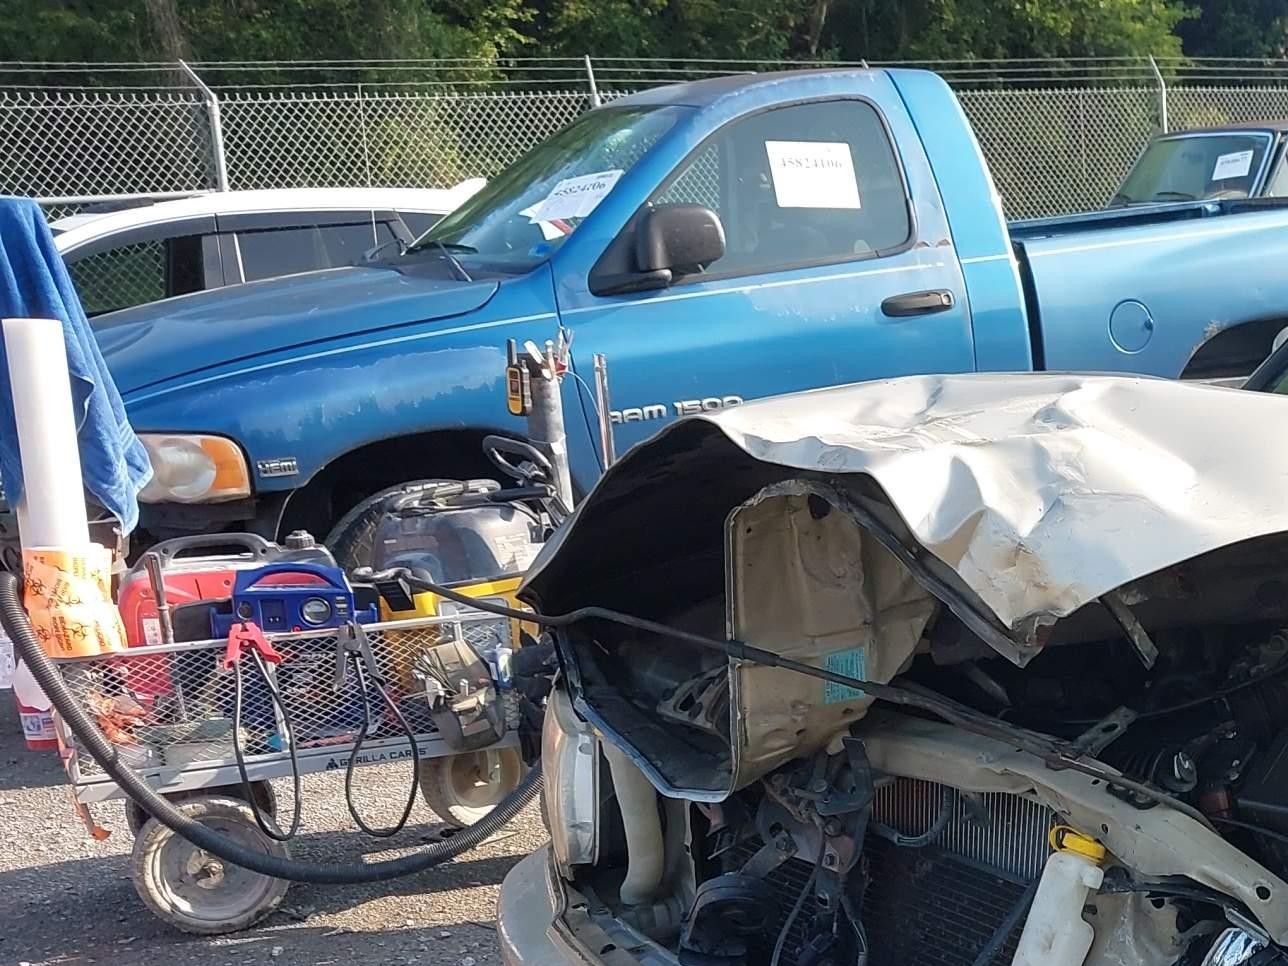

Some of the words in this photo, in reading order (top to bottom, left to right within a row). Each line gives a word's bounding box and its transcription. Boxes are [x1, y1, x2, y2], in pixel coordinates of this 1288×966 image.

[608, 404, 667, 424] RAM
[672, 395, 744, 416] 1500
[389, 747, 428, 760] CARS
